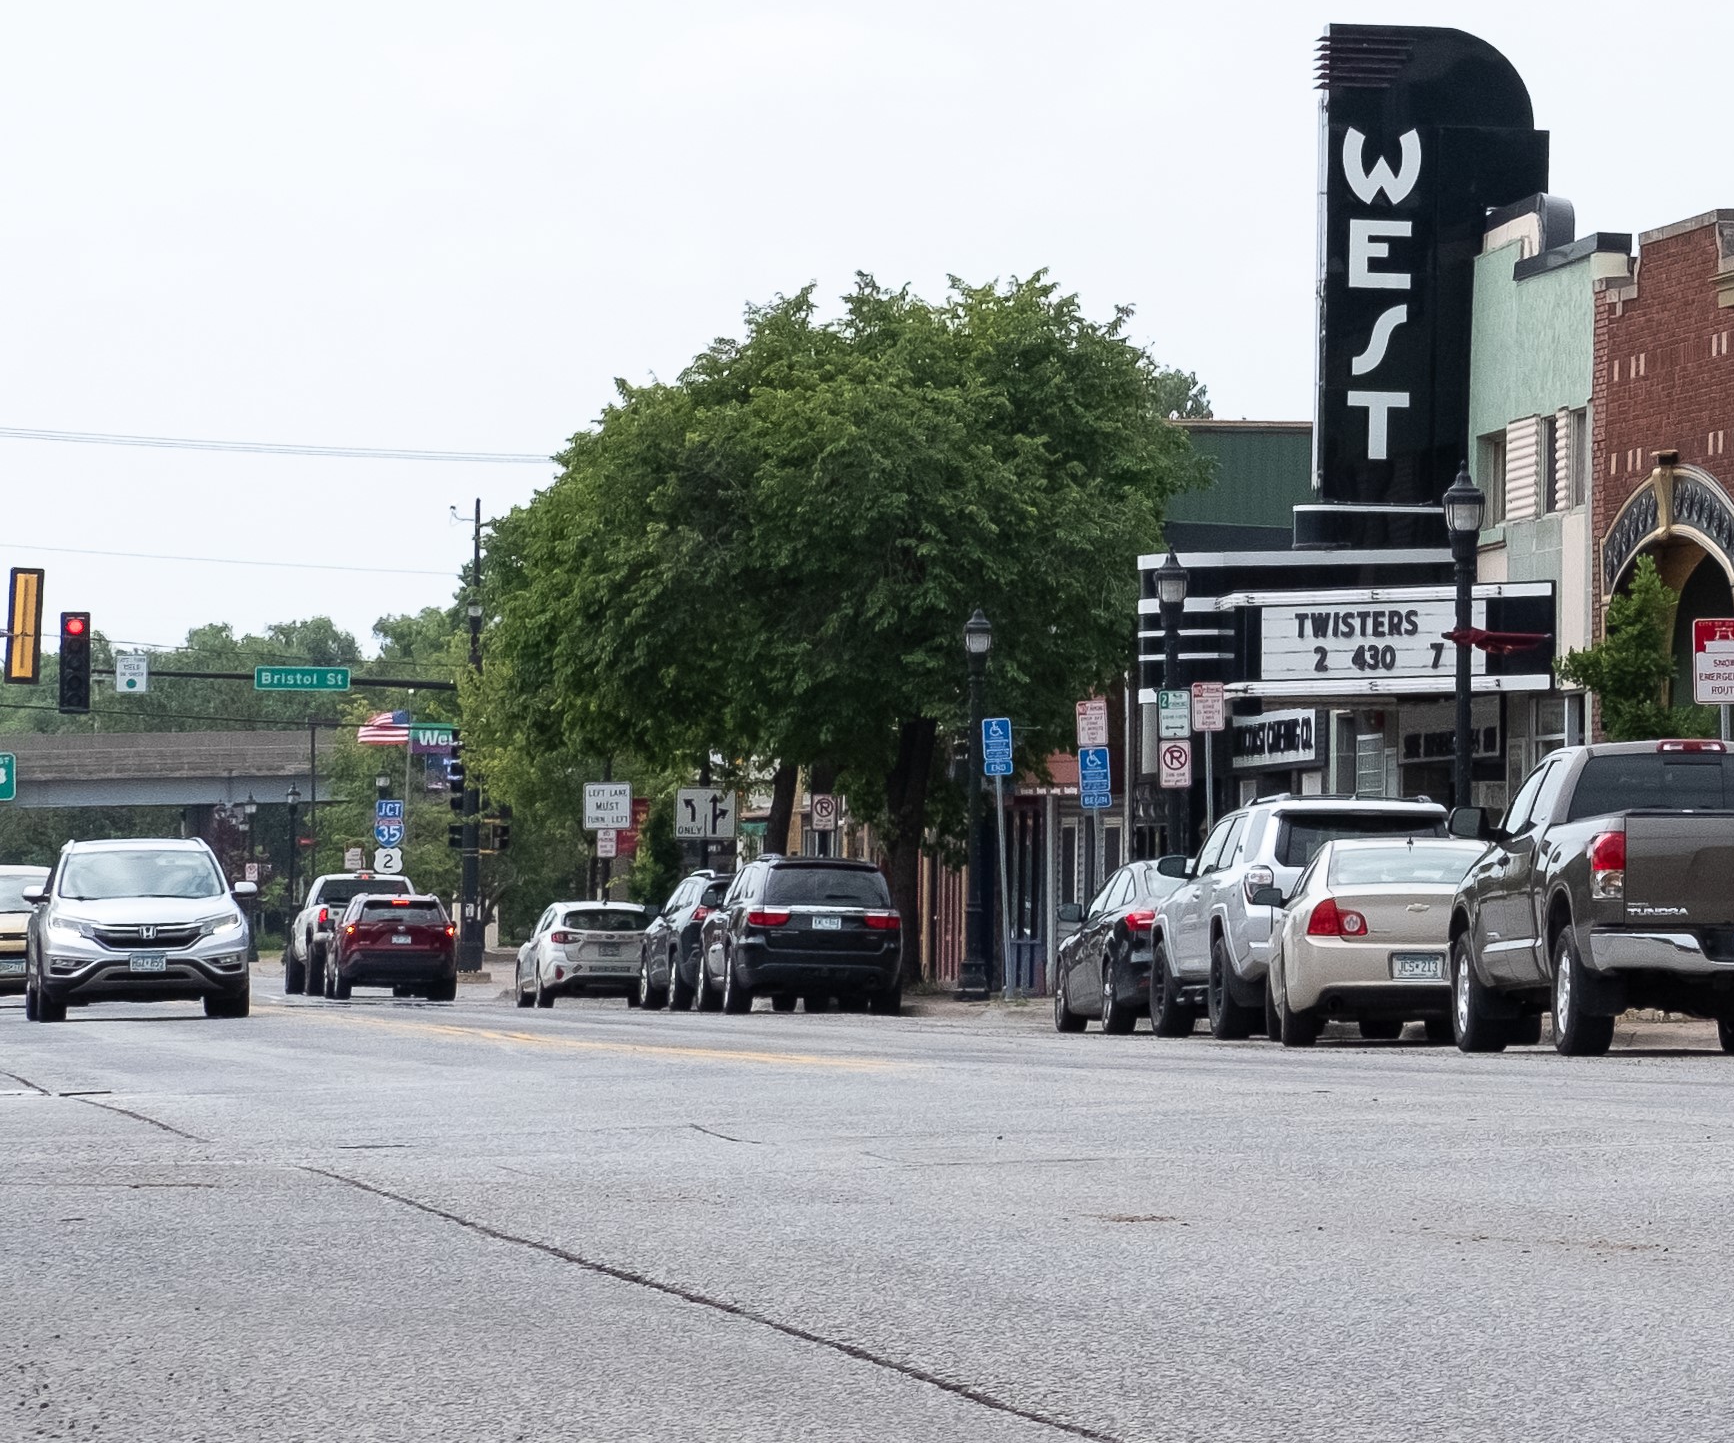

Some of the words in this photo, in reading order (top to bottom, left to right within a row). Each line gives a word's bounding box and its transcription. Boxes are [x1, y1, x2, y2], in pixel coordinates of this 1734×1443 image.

[1342, 126, 1422, 460] WEST
[1294, 610, 1418, 639] TWISTERS
[1313, 646, 1329, 672] 2
[1352, 644, 1396, 671] 430
[1430, 642, 1444, 669] 7
[261, 672, 317, 685] Bristol
[326, 672, 343, 685] St
[379, 803, 400, 816] JCT
[596, 802, 619, 811] MUST
[378, 825, 400, 842] 35
[678, 826, 702, 835] ONLY
[383, 853, 394, 868] 2
[1627, 907, 1689, 916] TUNDRA
